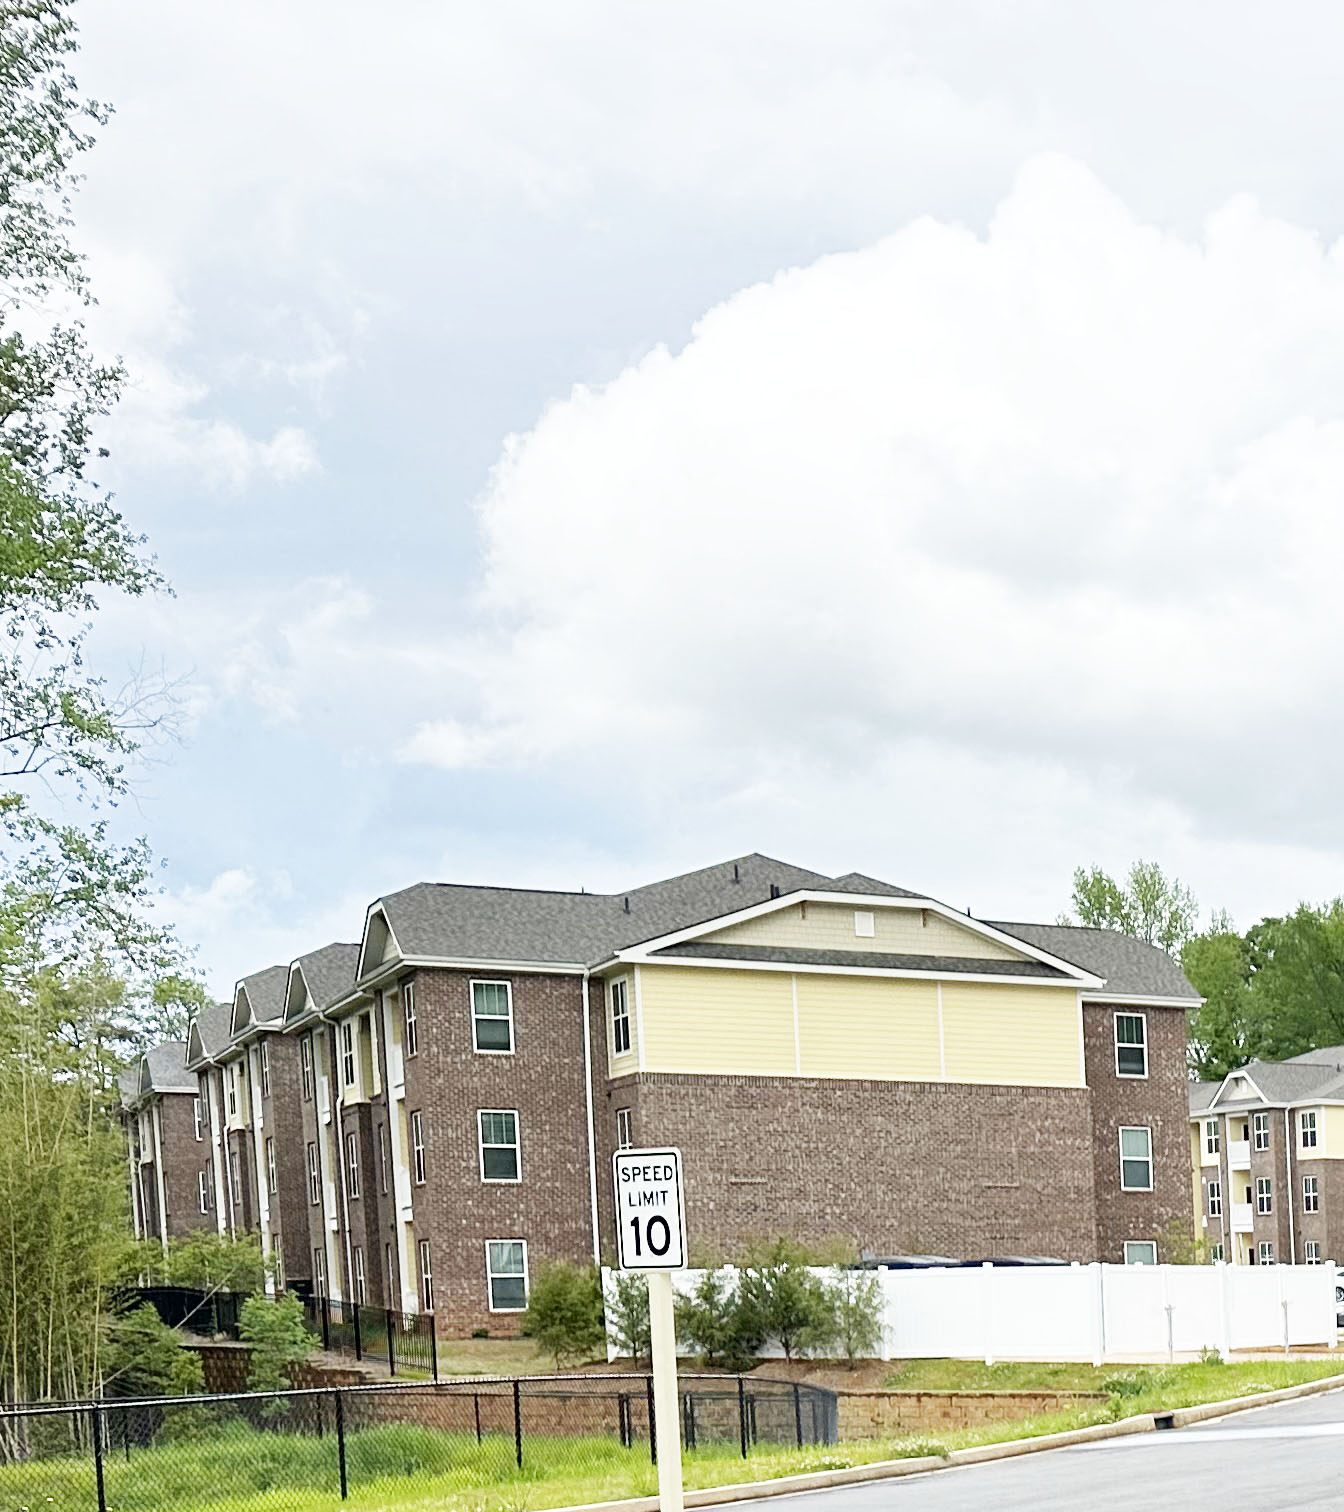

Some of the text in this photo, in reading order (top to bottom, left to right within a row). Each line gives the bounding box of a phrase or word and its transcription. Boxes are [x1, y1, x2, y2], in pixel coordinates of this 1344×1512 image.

[621, 1165, 673, 1183] SPEED
[628, 1190, 669, 1208] LIMIT
[630, 1215, 671, 1257] 10
